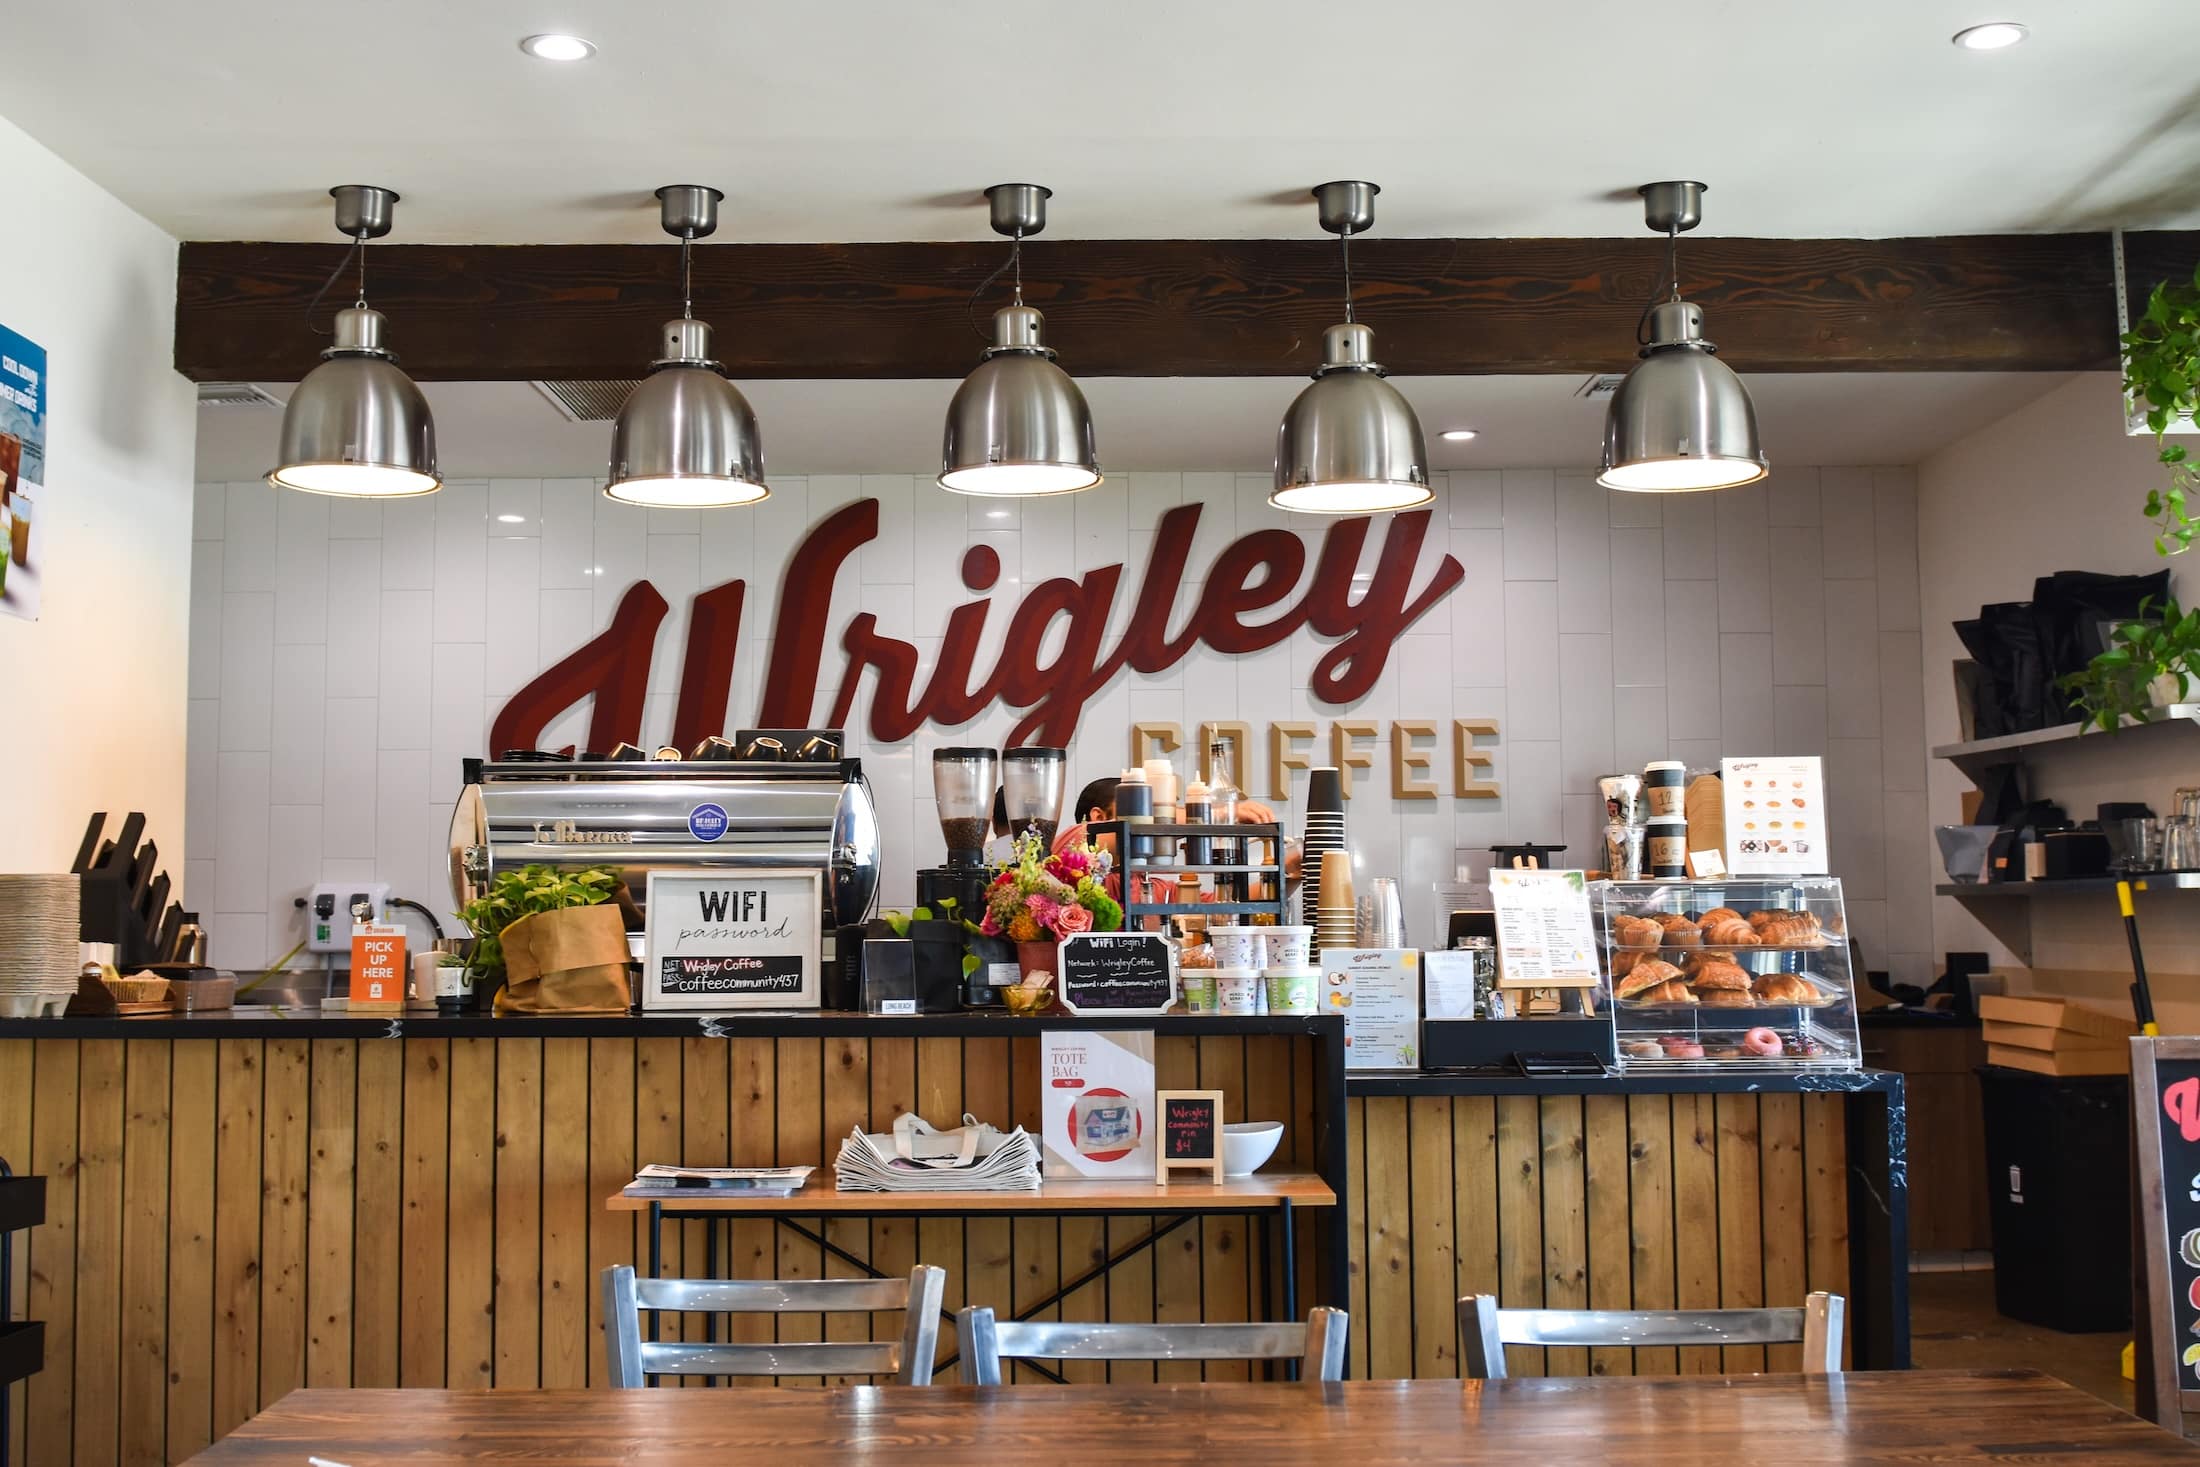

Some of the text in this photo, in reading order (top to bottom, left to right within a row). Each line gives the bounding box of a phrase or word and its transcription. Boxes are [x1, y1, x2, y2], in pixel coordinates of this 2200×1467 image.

[491, 497, 1465, 757] Wrigley
[1131, 719, 1500, 801] COFFEE
[699, 891, 767, 922] WIFI
[675, 917, 793, 951] password
[364, 941, 393, 953] PICK
[369, 955, 388, 966] UP
[723, 958, 764, 971] Coffee
[362, 967, 393, 978] HERE
[1051, 1053, 1087, 1065] TOTE
[1052, 1066, 1078, 1077] BAG
